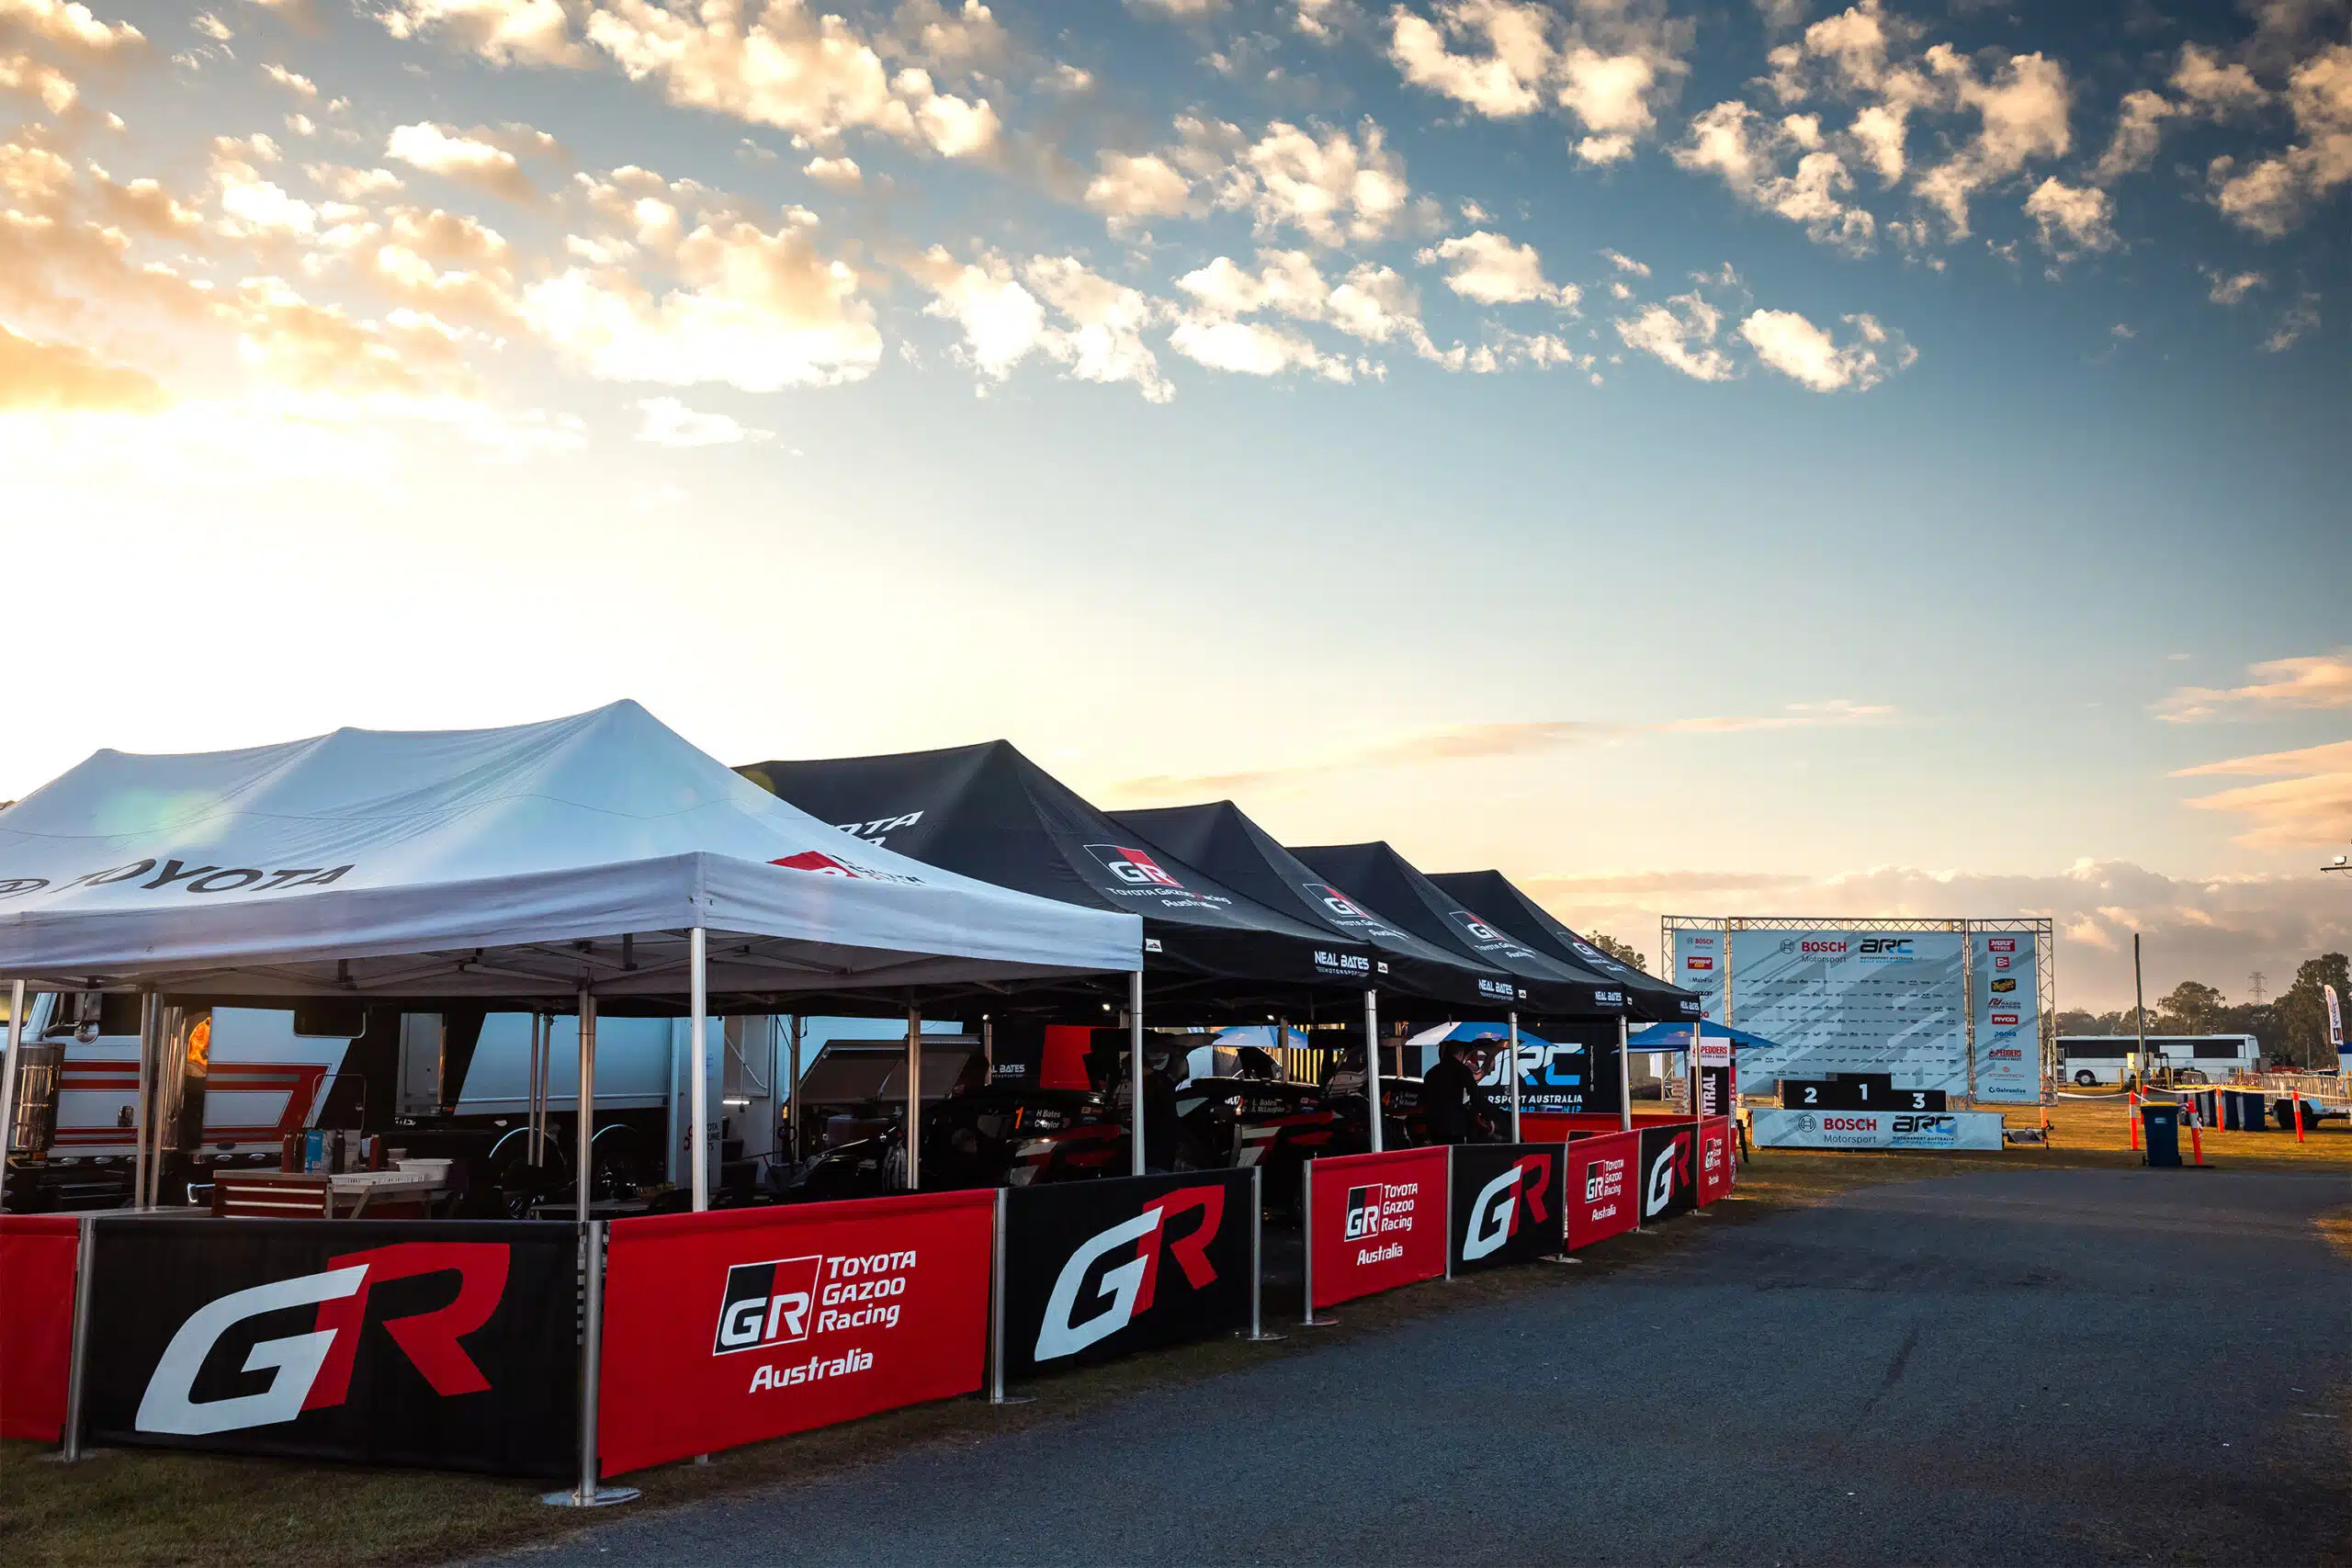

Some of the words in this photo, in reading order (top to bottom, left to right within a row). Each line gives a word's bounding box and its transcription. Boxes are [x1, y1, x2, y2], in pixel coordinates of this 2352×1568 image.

[46, 858, 356, 897] TOYOTA
[1109, 861, 1178, 885] GR
[1105, 887, 1156, 897] TOYOTA
[1801, 942, 1847, 953] BOSCH
[1860, 939, 1914, 953] ARC
[1314, 951, 1339, 966] NEAL
[1340, 954, 1370, 970] BATES
[1801, 955, 1847, 964] Motorsport
[1478, 978, 1495, 991] NEAL
[1495, 982, 1513, 995] BATES
[1594, 991, 1607, 1001] NEAL
[1701, 1045, 1727, 1055] PEDDERS
[1996, 1049, 2022, 1057] PEDDERS
[1000, 1064, 1025, 1073] BATES
[1528, 1094, 1583, 1103] AUSTRALIA
[1804, 1087, 1817, 1103] 2
[1859, 1083, 1868, 1100] 1
[1913, 1092, 1925, 1110] 3
[1015, 1106, 1024, 1130] 1
[1042, 1109, 1061, 1118] Bates
[1824, 1118, 1877, 1131] BOSCH
[1892, 1115, 1956, 1134] ARC
[1824, 1134, 1877, 1144] Motorsport
[1605, 1159, 1624, 1170] TOYOTA
[1604, 1171, 1623, 1183] GAZOO
[1646, 1131, 1691, 1217] GR
[1384, 1182, 1419, 1199] TOYOTA
[1586, 1177, 1604, 1200] GR
[1604, 1182, 1622, 1197] Racing
[1383, 1200, 1414, 1215] GAZOO
[1462, 1153, 1552, 1261] GR
[1591, 1203, 1617, 1222] Australia
[1346, 1205, 1379, 1237] GR
[1381, 1214, 1413, 1232] Racing
[1356, 1242, 1404, 1266] Australia
[827, 1250, 917, 1280] TOYOTA
[1034, 1184, 1226, 1362] GR
[822, 1277, 906, 1306] GAZOO
[720, 1292, 809, 1347] GR
[817, 1303, 900, 1334] Racing
[135, 1242, 511, 1436] GR
[749, 1348, 874, 1394] Australia
